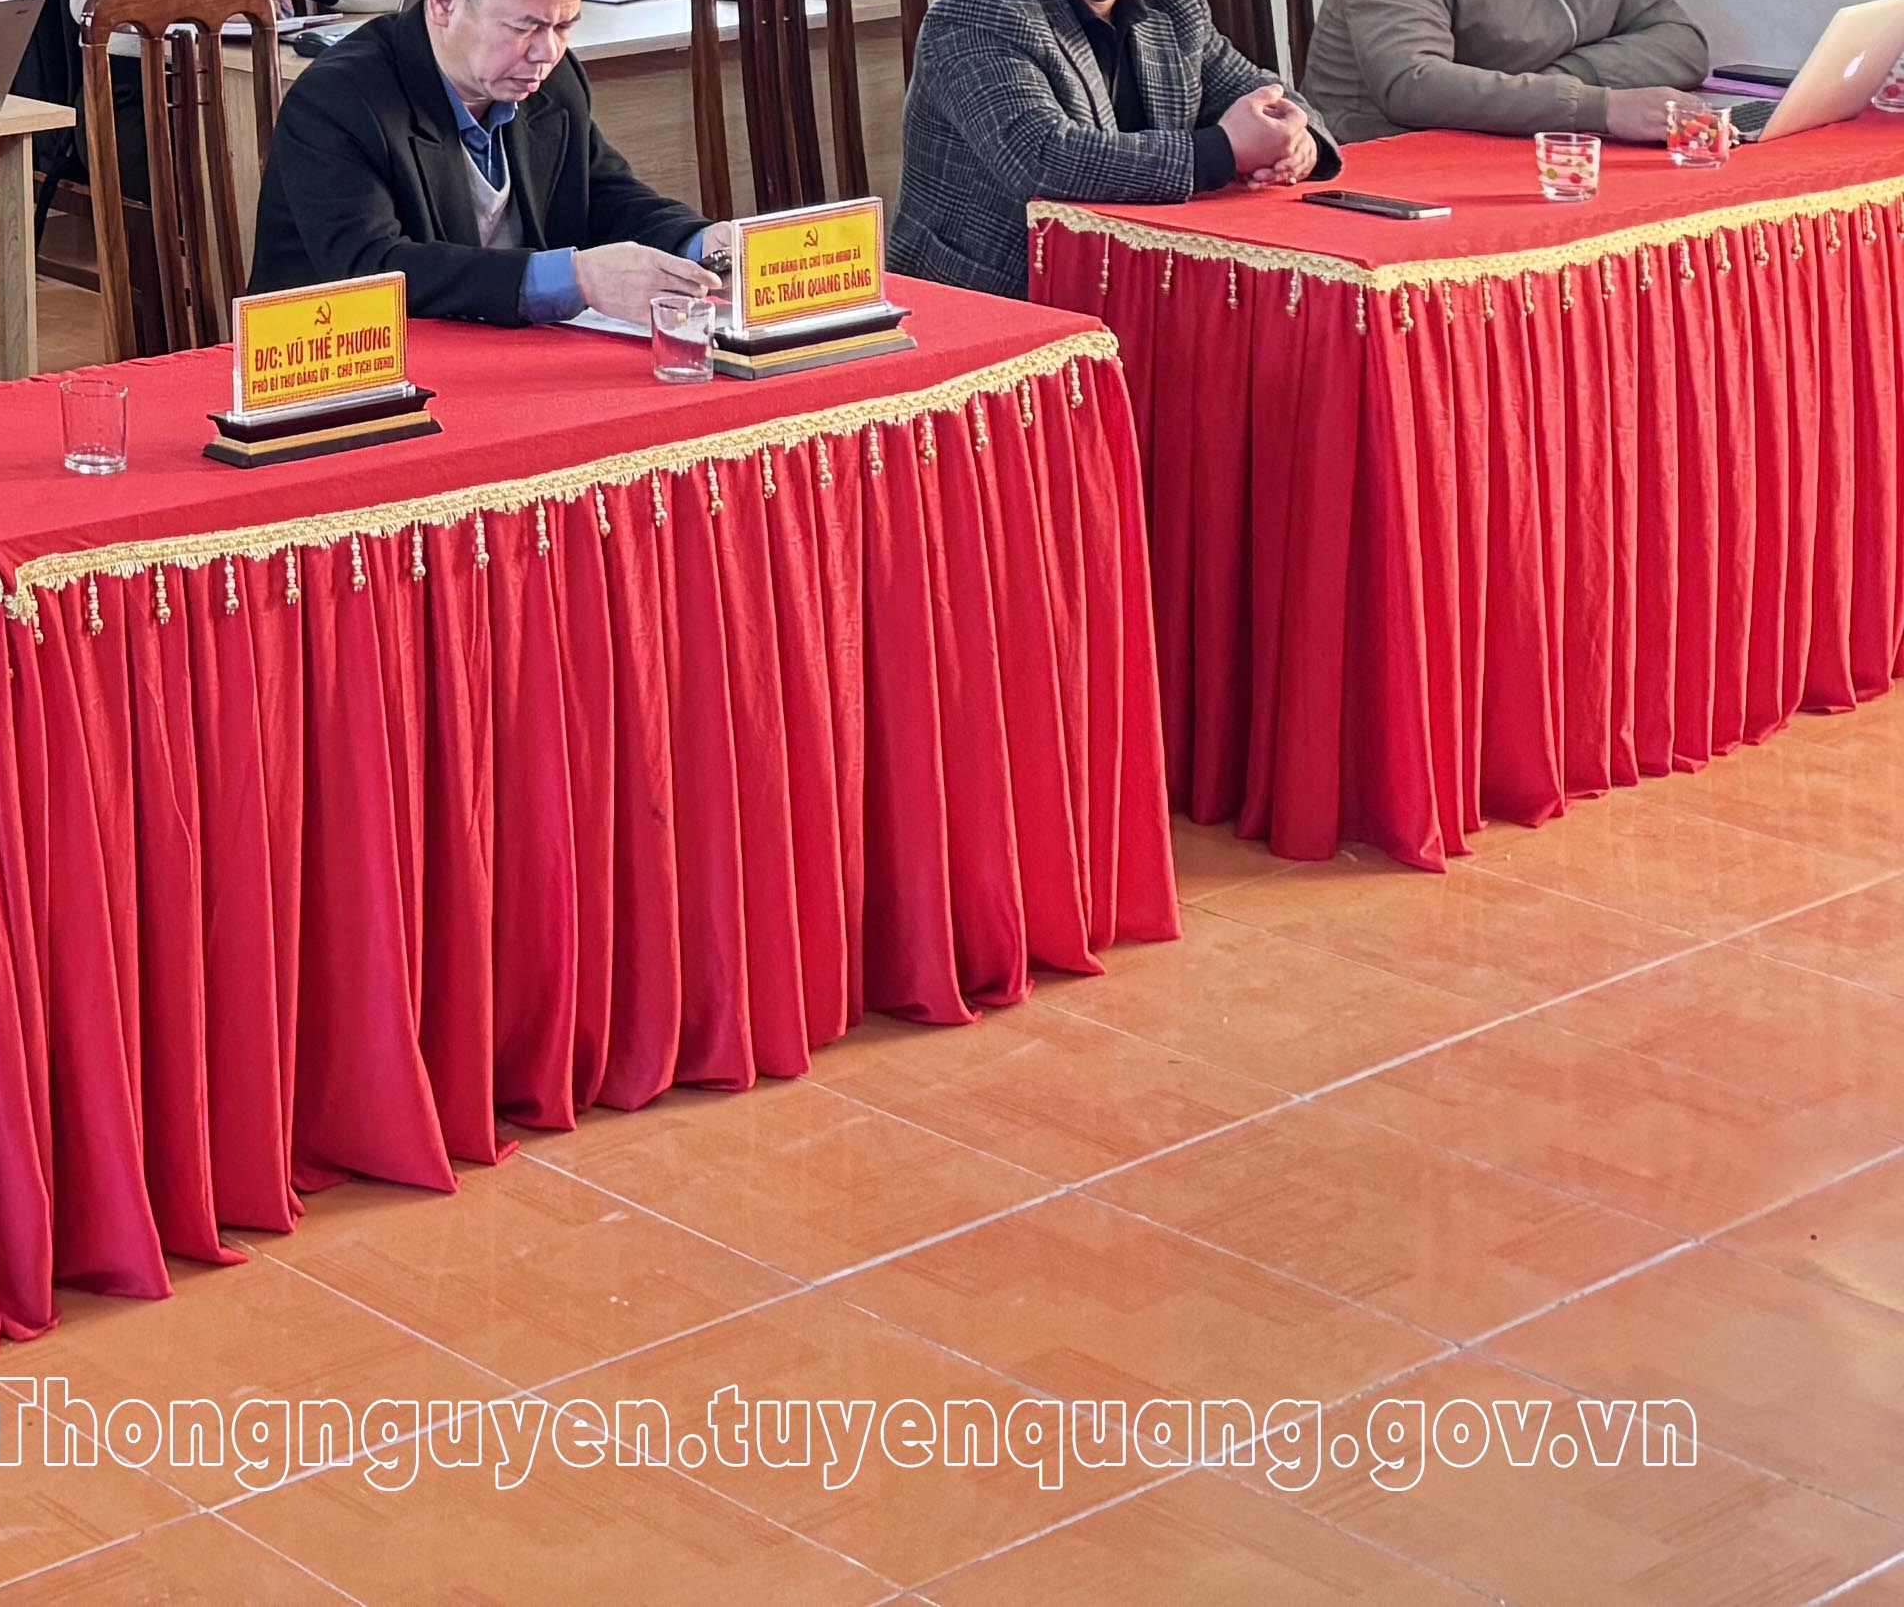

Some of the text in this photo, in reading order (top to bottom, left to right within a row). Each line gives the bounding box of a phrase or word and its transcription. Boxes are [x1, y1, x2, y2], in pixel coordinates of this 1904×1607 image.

[808, 273, 841, 299] QUANG
[255, 345, 282, 372] Đ/C:
[308, 328, 333, 362] THẾ
[337, 325, 391, 357] PHƯƠNG
